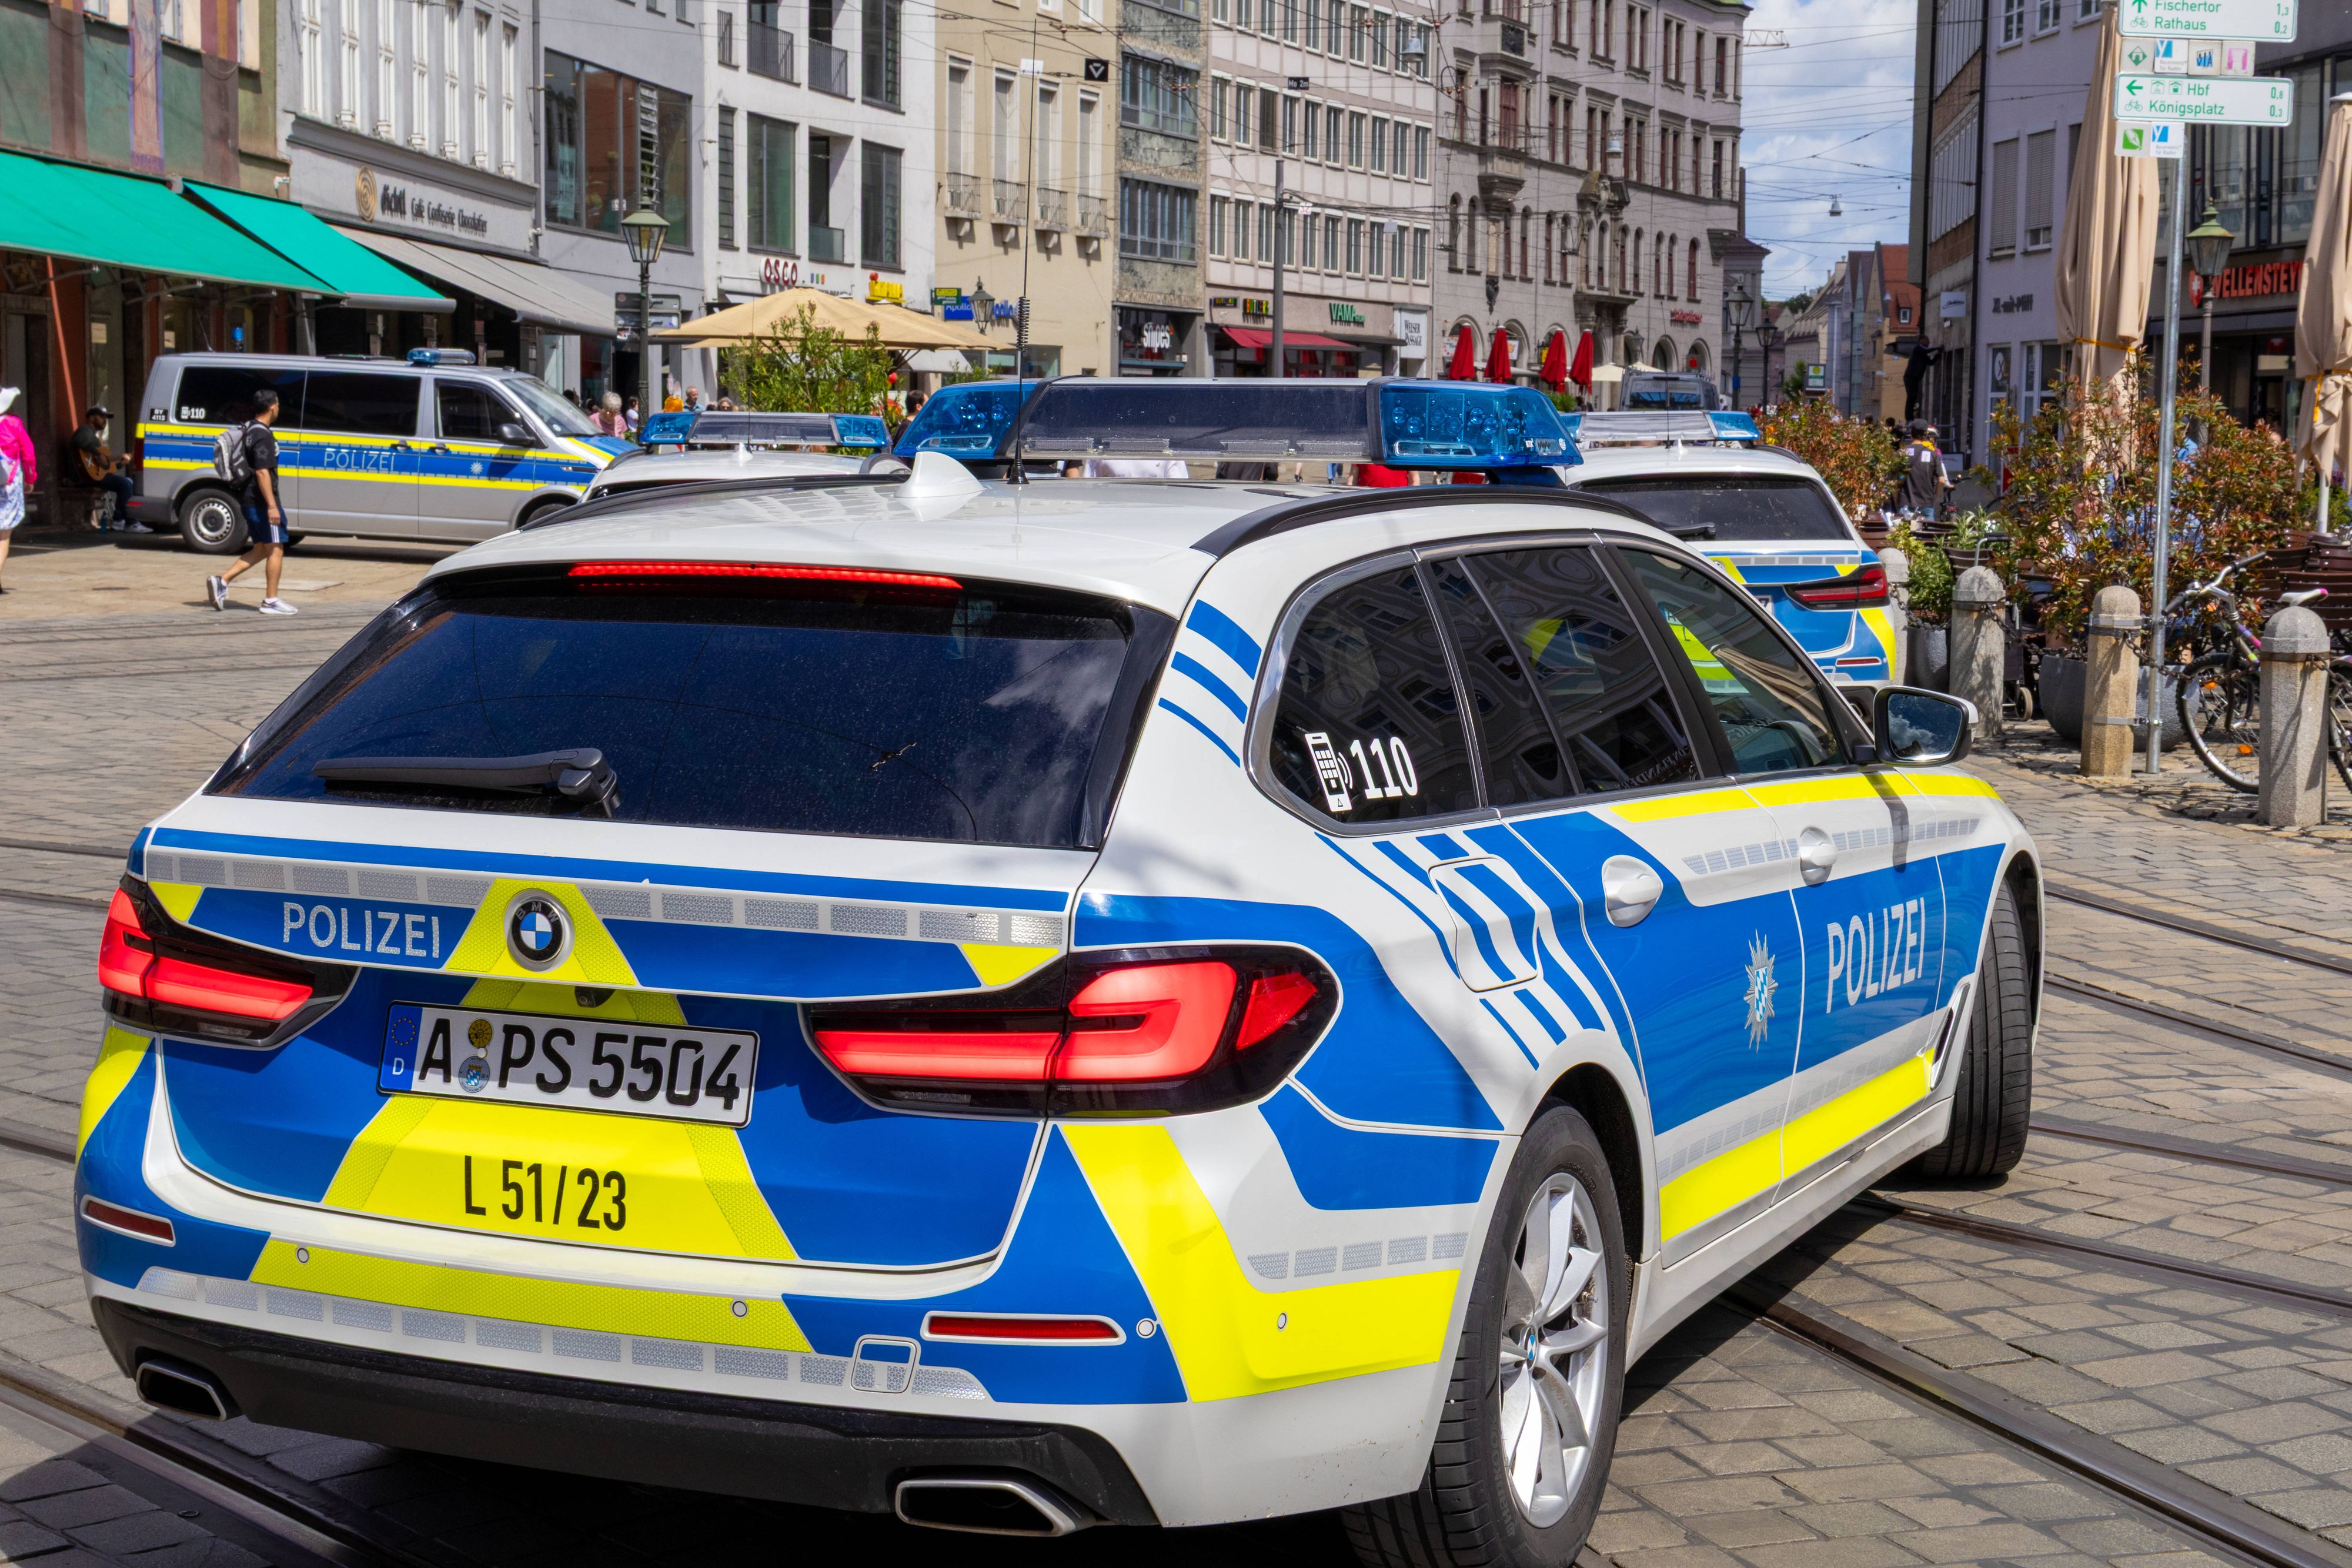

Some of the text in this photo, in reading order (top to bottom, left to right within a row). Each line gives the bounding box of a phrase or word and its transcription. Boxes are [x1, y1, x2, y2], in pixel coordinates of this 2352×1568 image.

[2155, 0, 2289, 16] Fischertor 1,3
[2154, 16, 2288, 34] Rathaus 0,2
[1299, 79, 1309, 88] 2m
[2187, 83, 2284, 99] Hbf 0,8
[2149, 99, 2283, 118] Königsplatz 0,3
[427, 201, 456, 226] Confiserie
[457, 209, 488, 233] Chocolatier
[991, 299, 1013, 319] pollo
[1245, 298, 1269, 315] BUTLERS
[1329, 302, 1357, 323] VAMA
[1404, 319, 1421, 334] WELSER
[1405, 332, 1422, 346] PASSAGE
[190, 407, 206, 419] 110
[324, 448, 395, 472] POLIZEI
[1349, 736, 1418, 800] 110
[516, 901, 559, 923] BMW
[282, 901, 440, 959] POLIZEI
[1826, 897, 1925, 1014] POLIZEI
[392, 1017, 742, 1111] D A PS 5504
[464, 1154, 626, 1232] L 51/23
